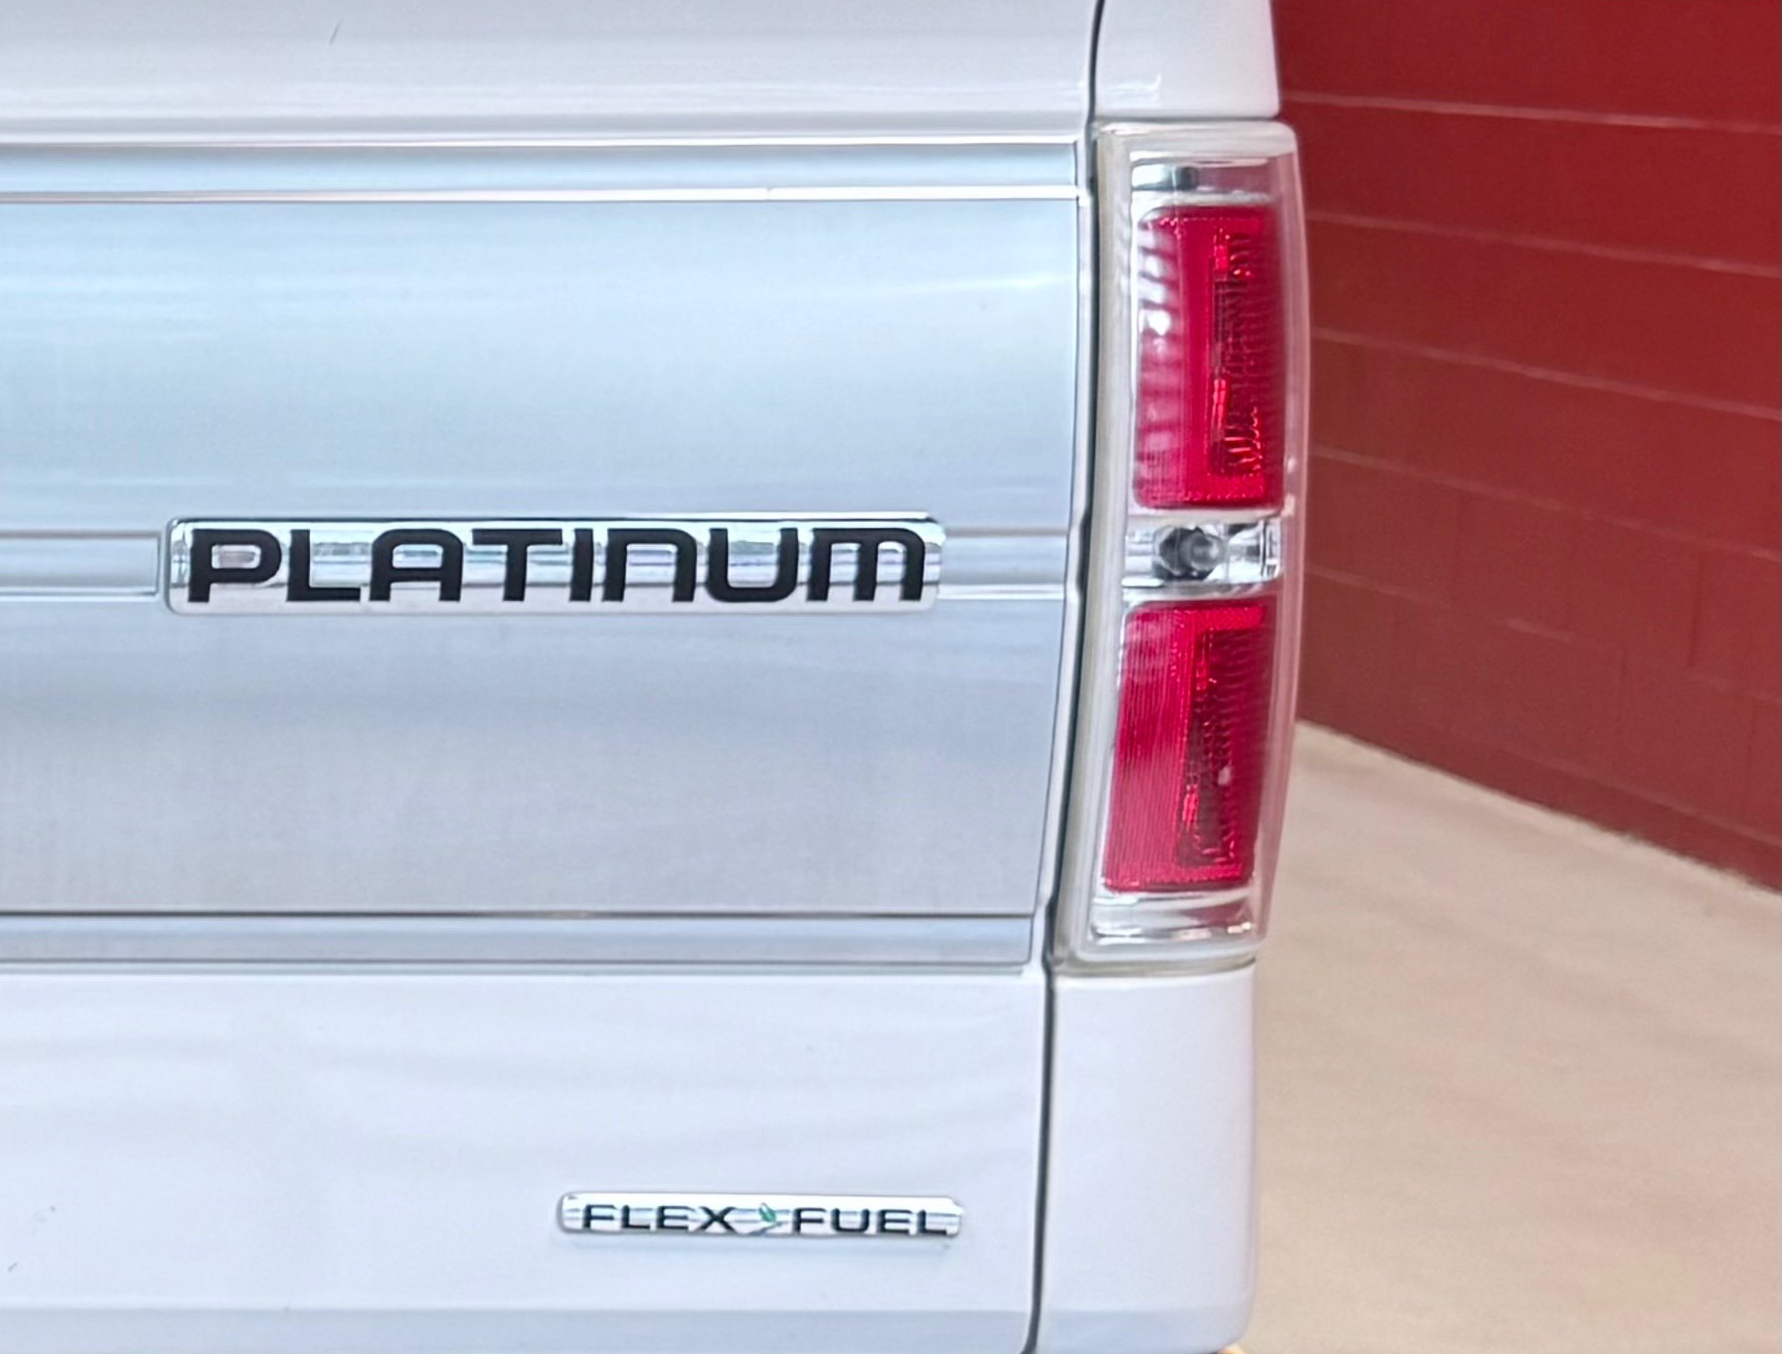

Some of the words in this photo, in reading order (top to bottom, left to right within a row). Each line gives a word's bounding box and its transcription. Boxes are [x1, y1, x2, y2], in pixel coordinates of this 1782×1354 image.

[185, 527, 928, 605] PLATINUM
[582, 1203, 736, 1233] FLEX
[791, 1206, 948, 1235] FUEL
